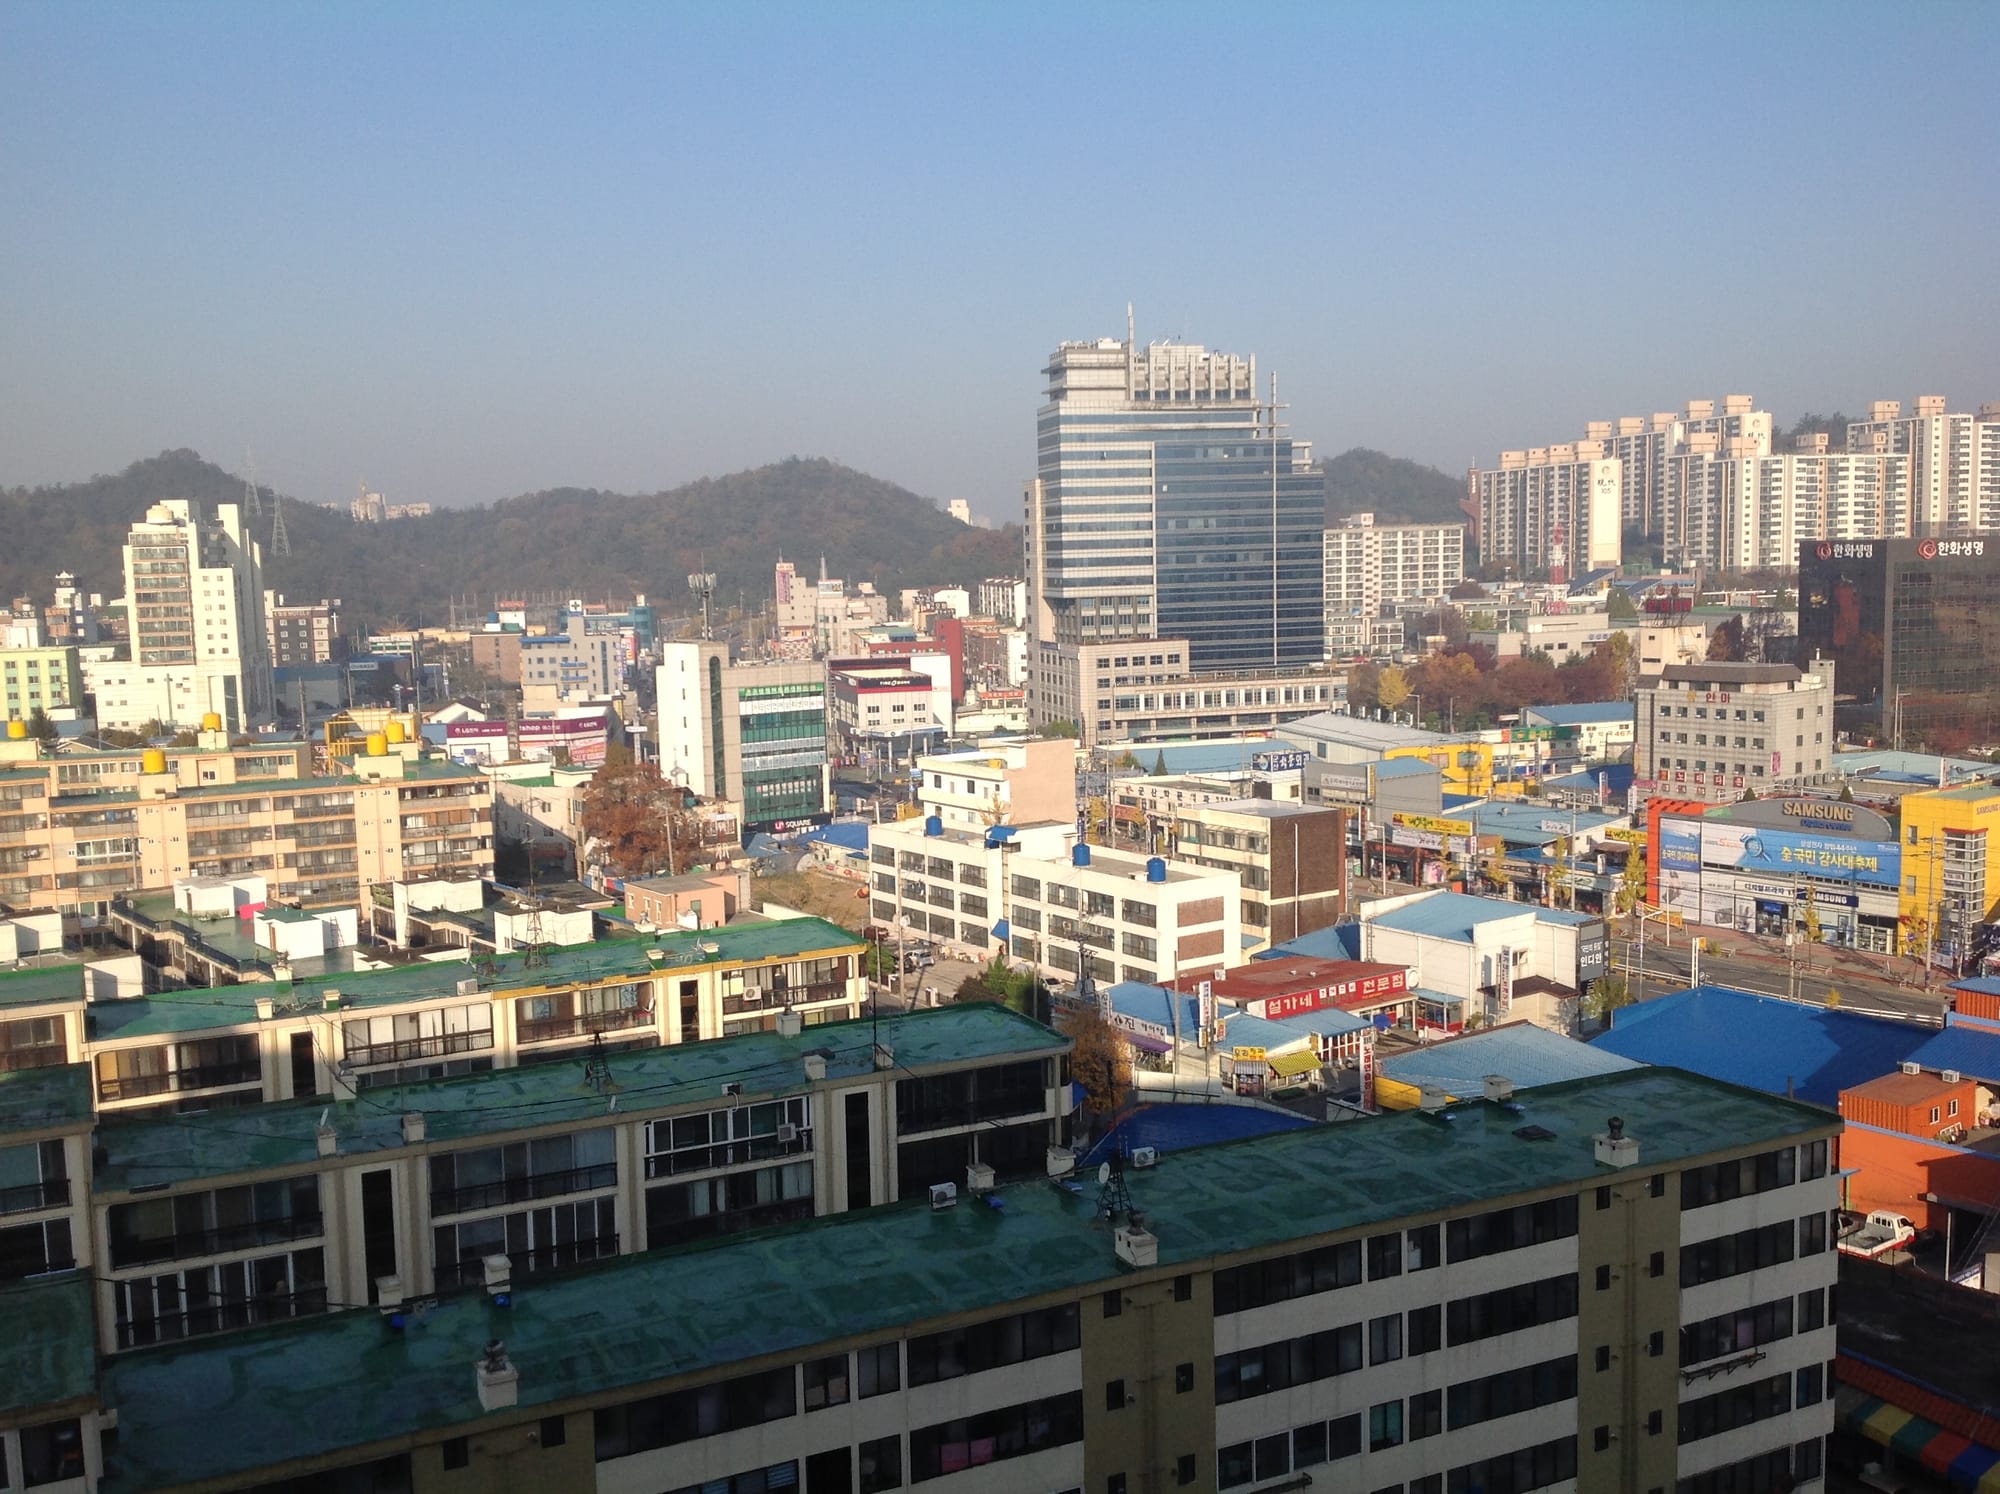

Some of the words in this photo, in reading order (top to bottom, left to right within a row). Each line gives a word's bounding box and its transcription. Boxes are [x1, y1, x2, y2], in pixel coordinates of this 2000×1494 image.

[1833, 543, 1873, 559] 한화생명
[1937, 541, 1984, 557] 한화생명
[1783, 801, 1854, 821] SAMSUNG
[1806, 891, 1848, 905] MSUNG
[1580, 952, 1602, 967] 인디안
[1363, 973, 1404, 994] 전문점
[1125, 1016, 1136, 1031] 진
